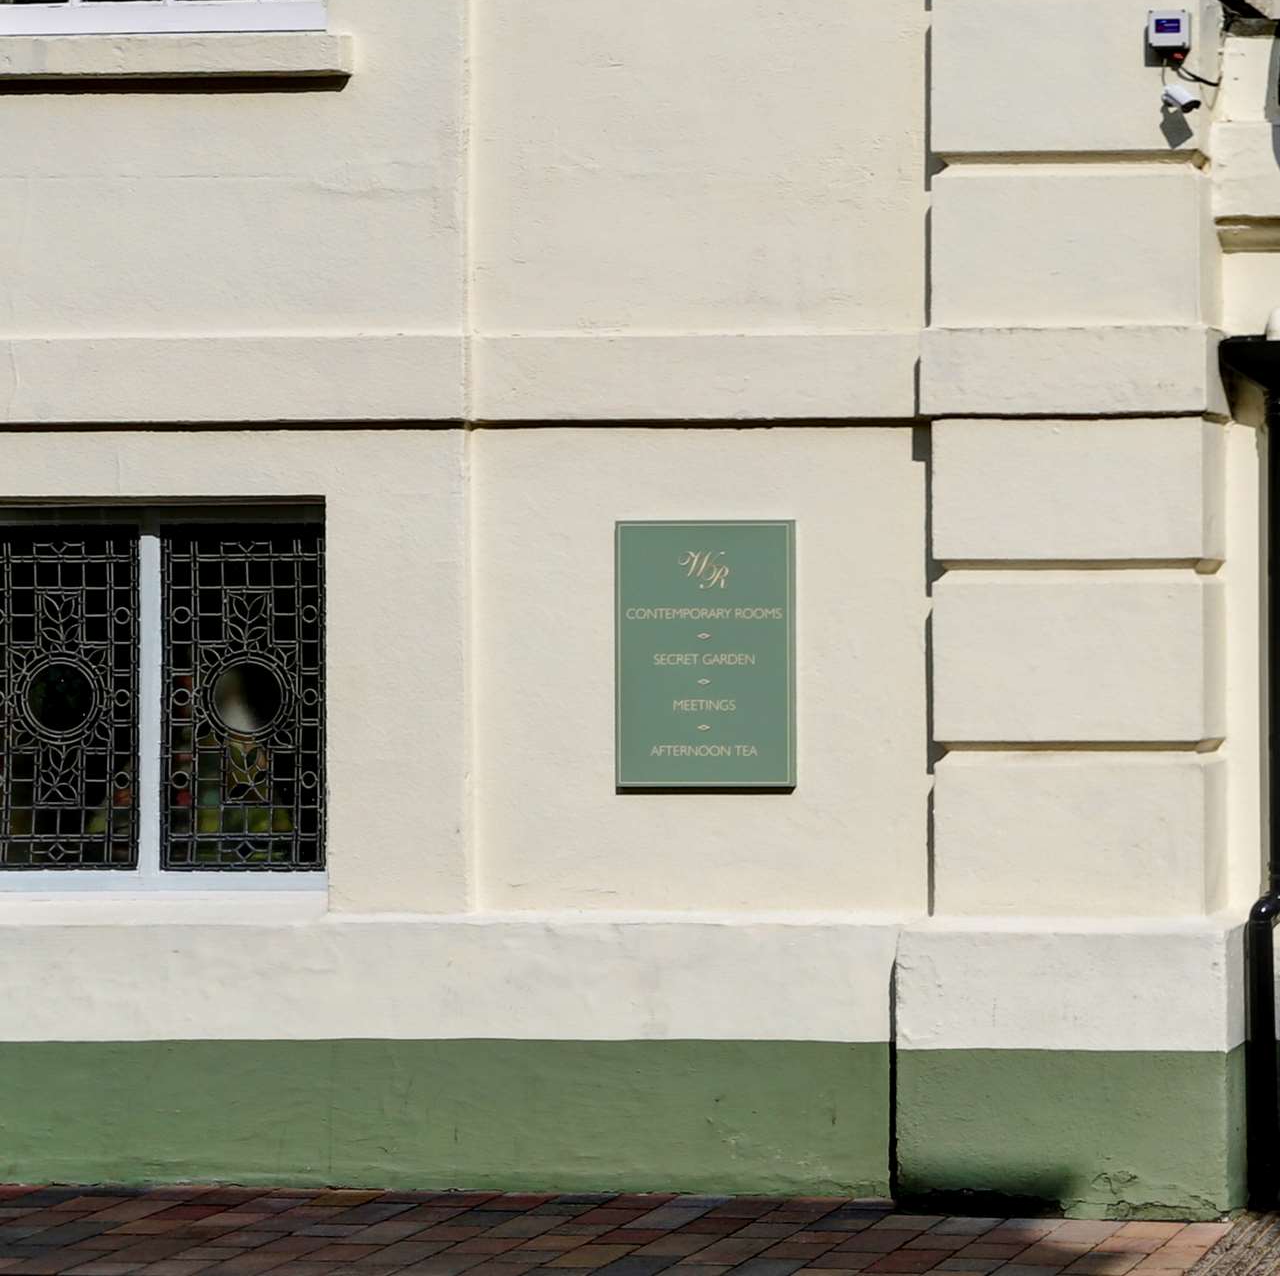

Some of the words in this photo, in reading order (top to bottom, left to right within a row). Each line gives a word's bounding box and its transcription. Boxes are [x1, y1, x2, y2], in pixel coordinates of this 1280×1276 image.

[625, 607, 732, 620] CONTEMPORARY
[734, 607, 783, 620] ROOMS
[653, 653, 698, 666] SECRET
[702, 653, 755, 666] GARDEN
[672, 699, 736, 712] MEETINGS
[650, 745, 732, 757] AFTERNOON
[734, 745, 758, 757] TEA
